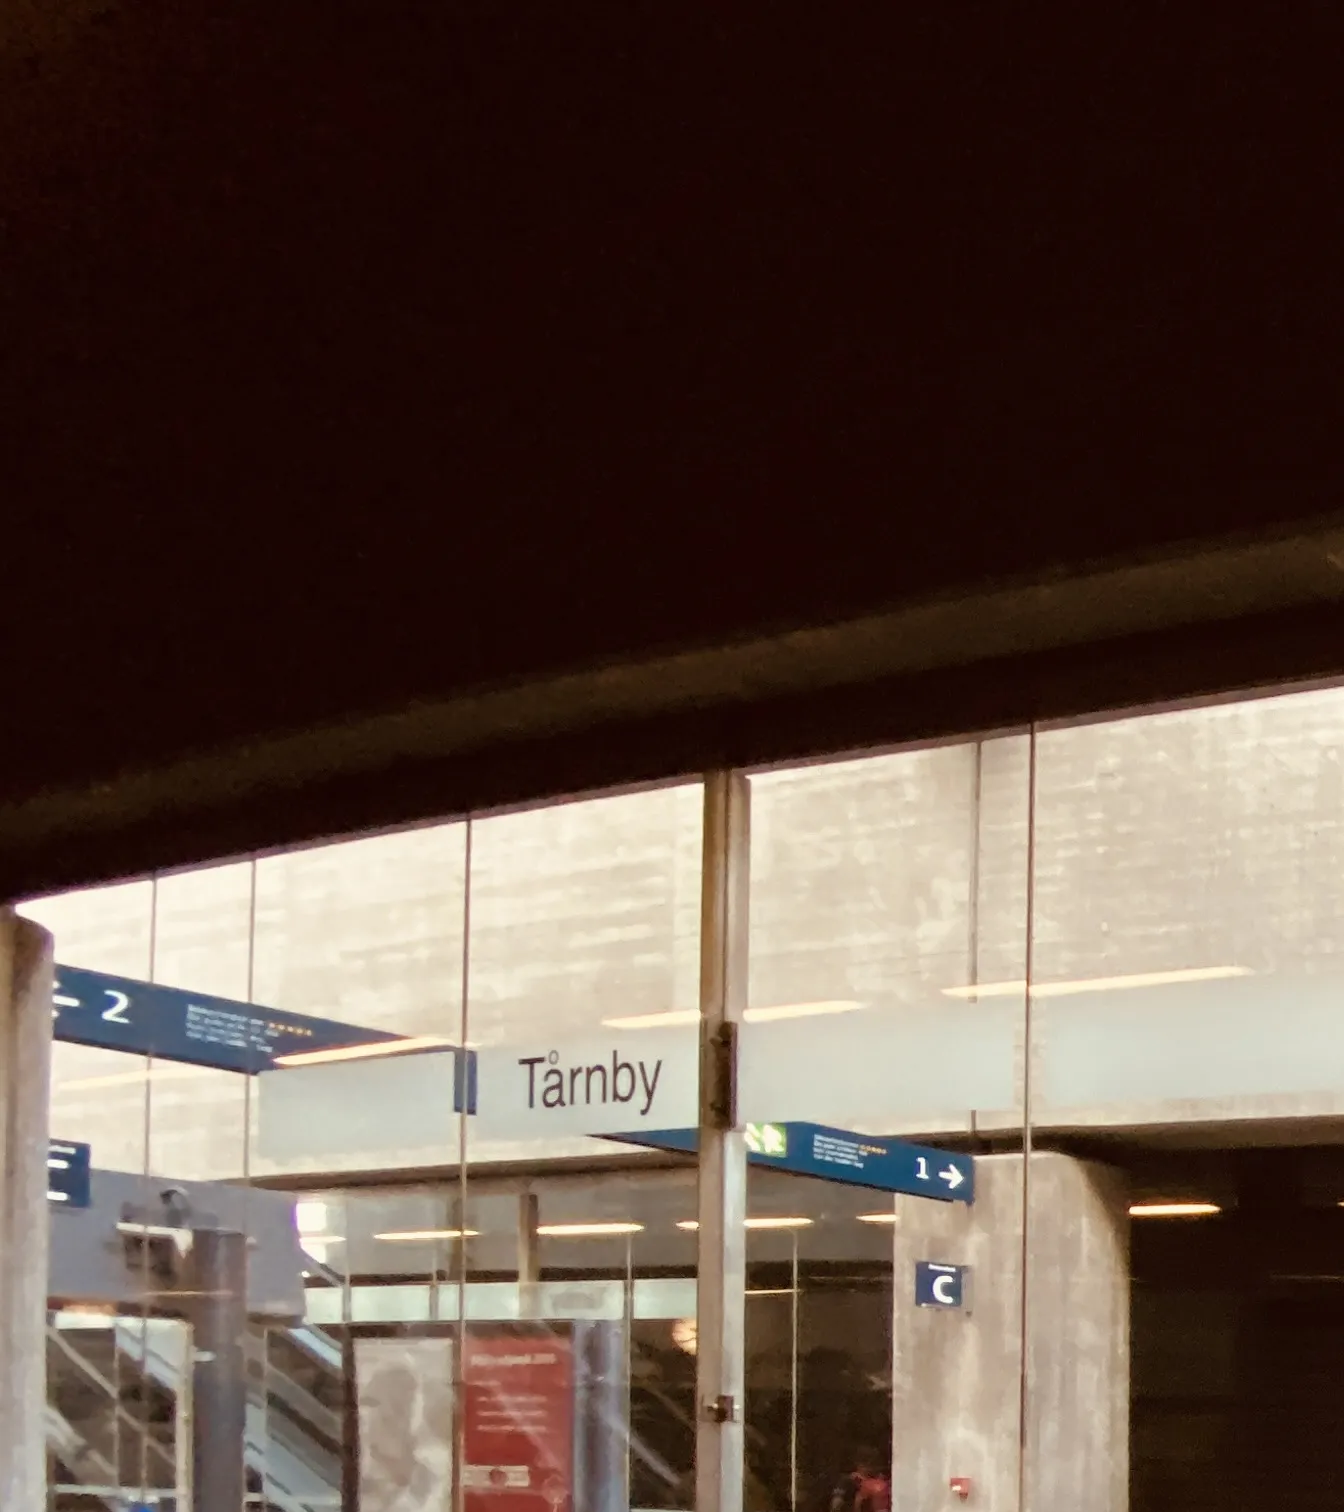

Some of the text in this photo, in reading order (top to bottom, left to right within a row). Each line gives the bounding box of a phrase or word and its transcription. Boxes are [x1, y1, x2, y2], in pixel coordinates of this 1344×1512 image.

[101, 989, 131, 1024] 2
[518, 1049, 662, 1116] Tårnby
[915, 1156, 930, 1180] 1
[932, 1274, 954, 1304] C
